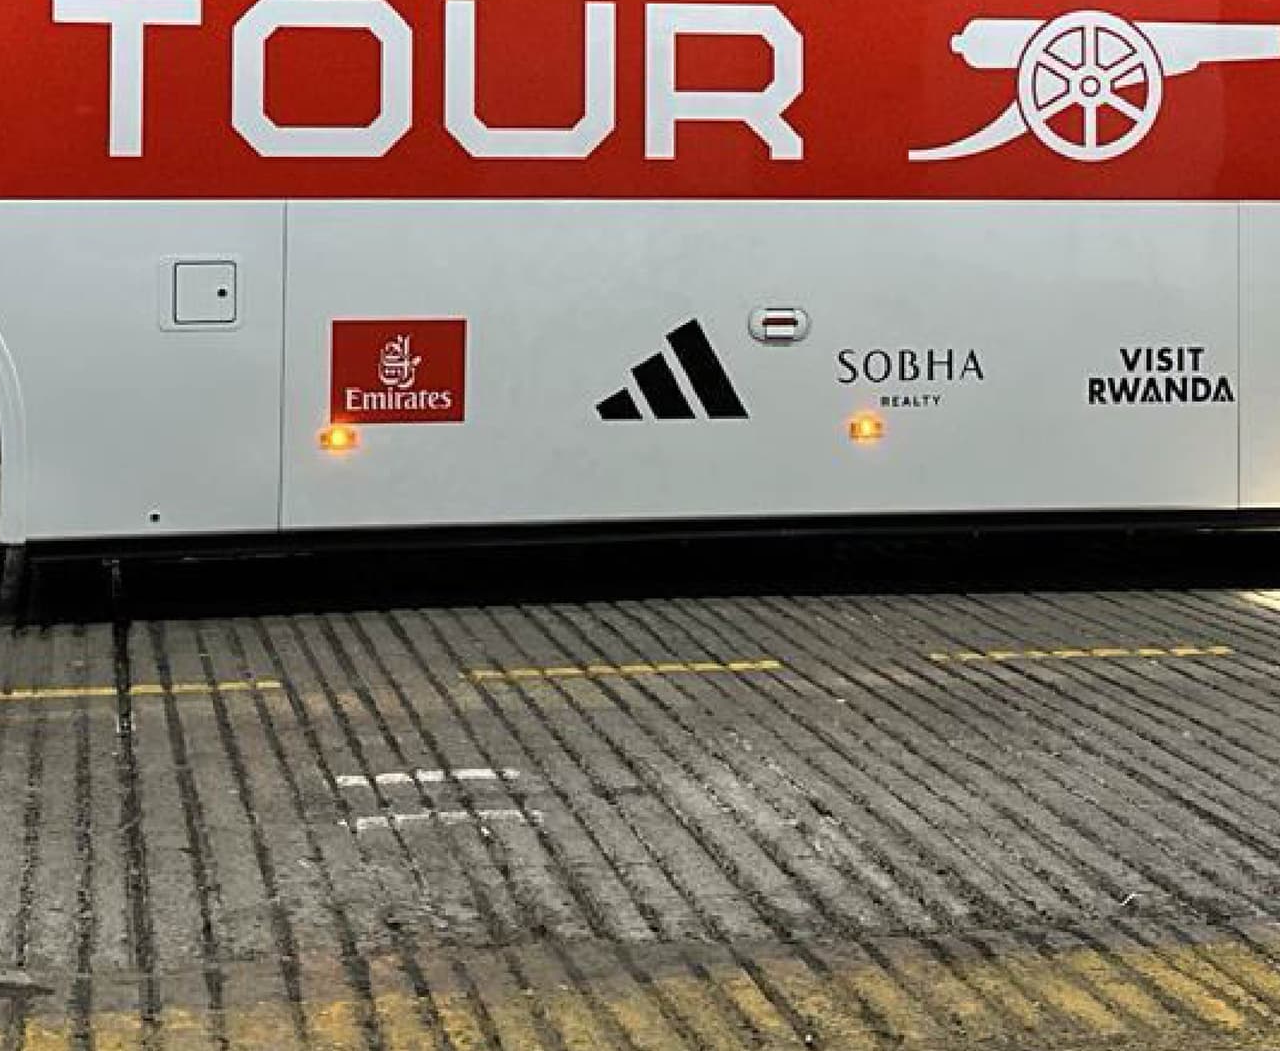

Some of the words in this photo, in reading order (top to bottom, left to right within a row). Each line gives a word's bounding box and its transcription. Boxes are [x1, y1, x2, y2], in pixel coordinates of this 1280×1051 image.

[837, 348, 984, 383] SOBHA
[1119, 346, 1205, 372] VISIT
[344, 386, 453, 411] Emirates
[880, 395, 942, 408] REALTY
[1088, 376, 1236, 404] RWANDA
